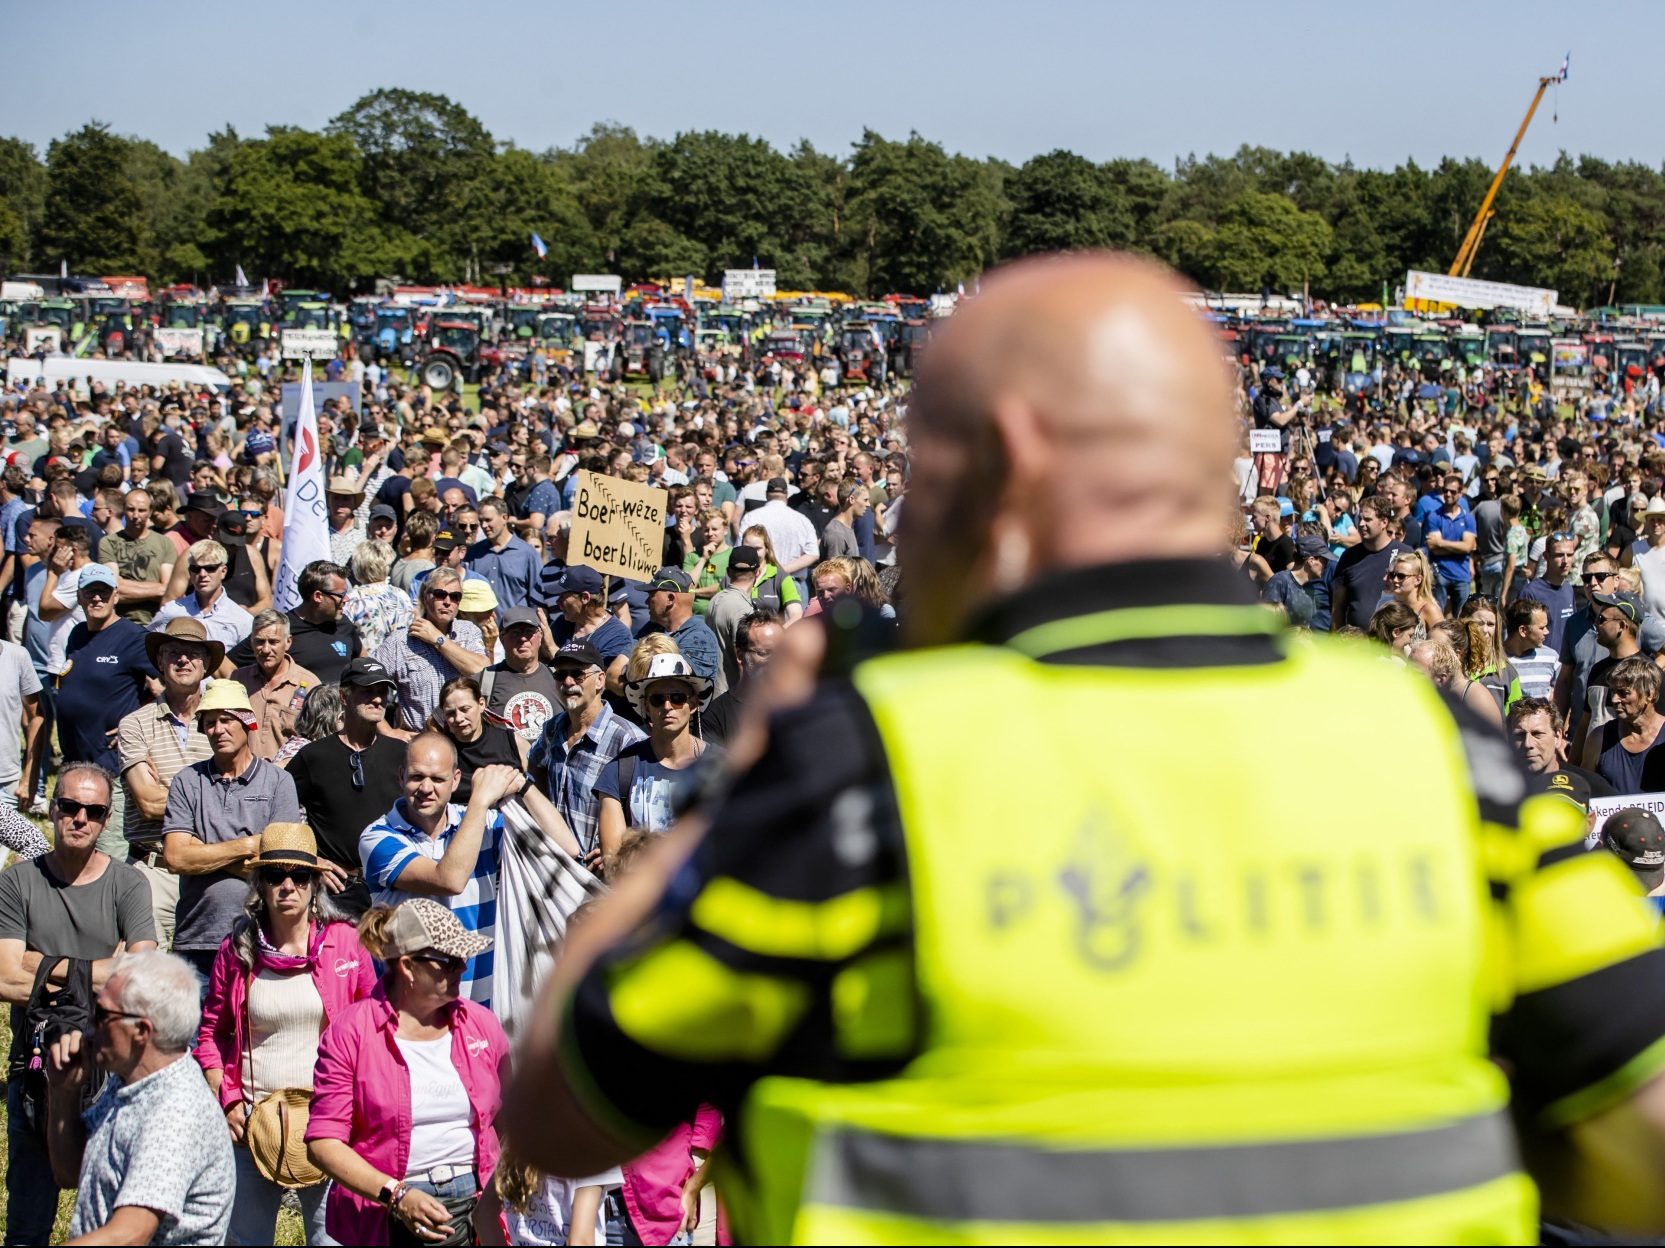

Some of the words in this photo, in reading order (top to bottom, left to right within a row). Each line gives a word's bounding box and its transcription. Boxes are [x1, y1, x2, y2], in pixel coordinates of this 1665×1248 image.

[578, 488, 615, 524] Boer
[623, 499, 662, 526] wêze,
[584, 530, 618, 562] boer
[619, 542, 658, 576] bliuwe
